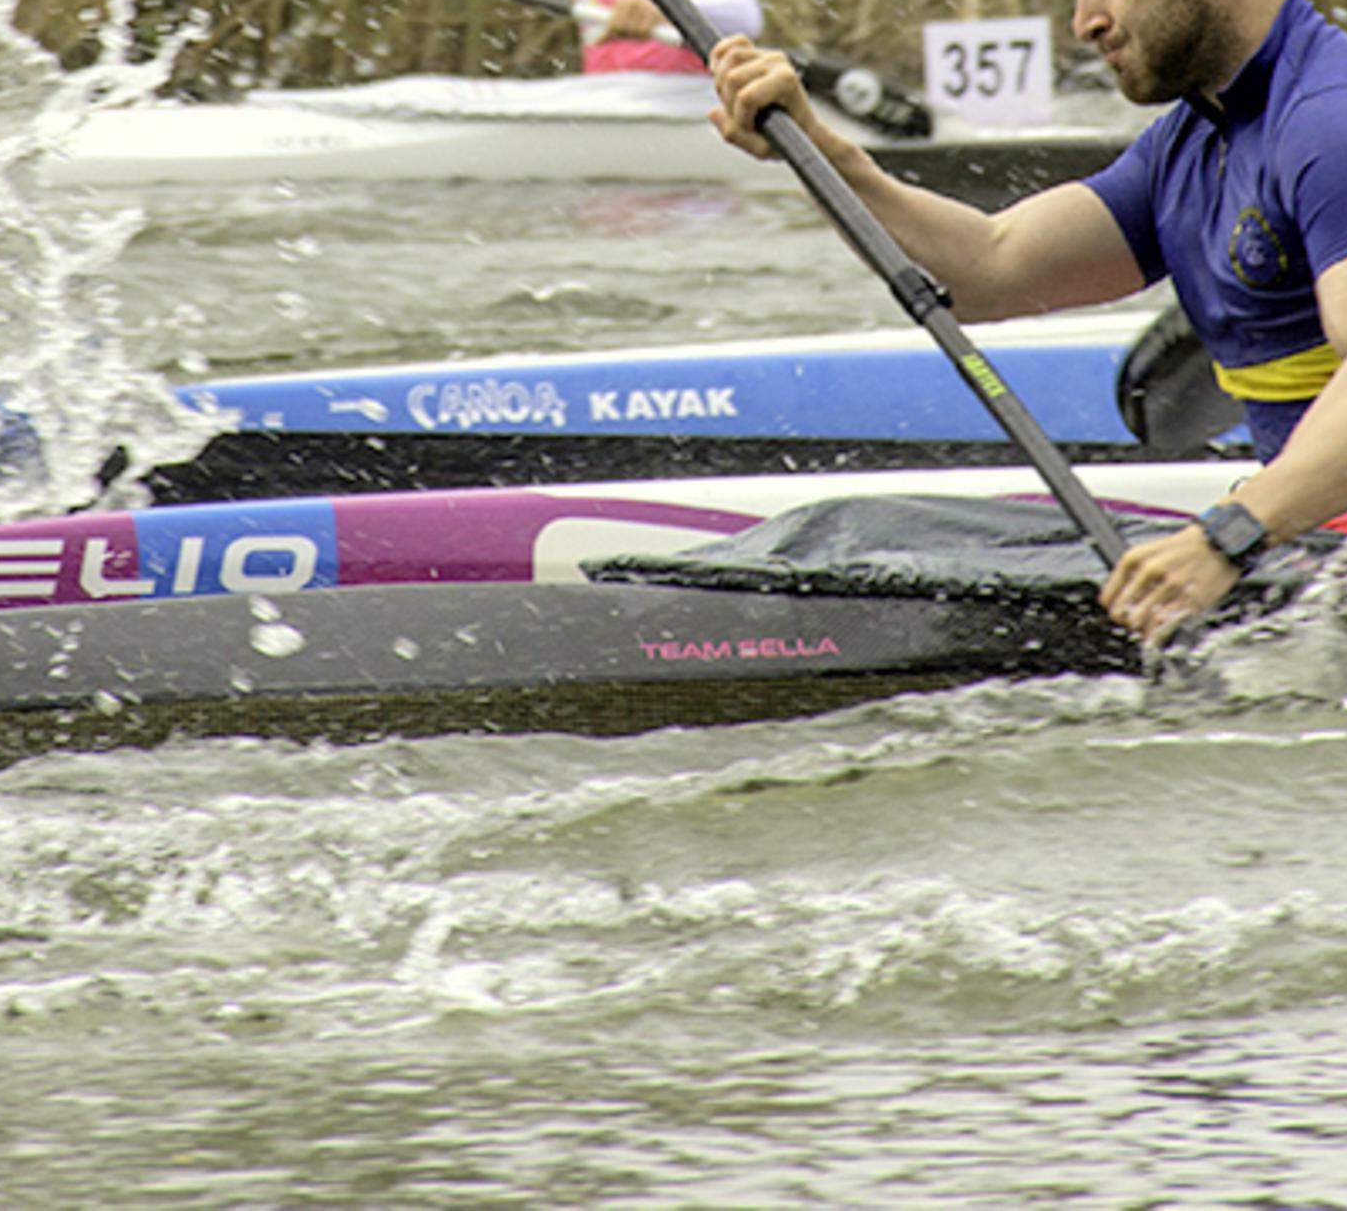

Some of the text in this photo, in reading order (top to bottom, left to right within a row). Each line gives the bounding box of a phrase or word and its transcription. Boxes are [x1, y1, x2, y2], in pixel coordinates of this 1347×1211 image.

[942, 39, 1033, 98] 357
[407, 378, 738, 431] CANOA KAYAK
[639, 637, 841, 661] TEAM SELLA
